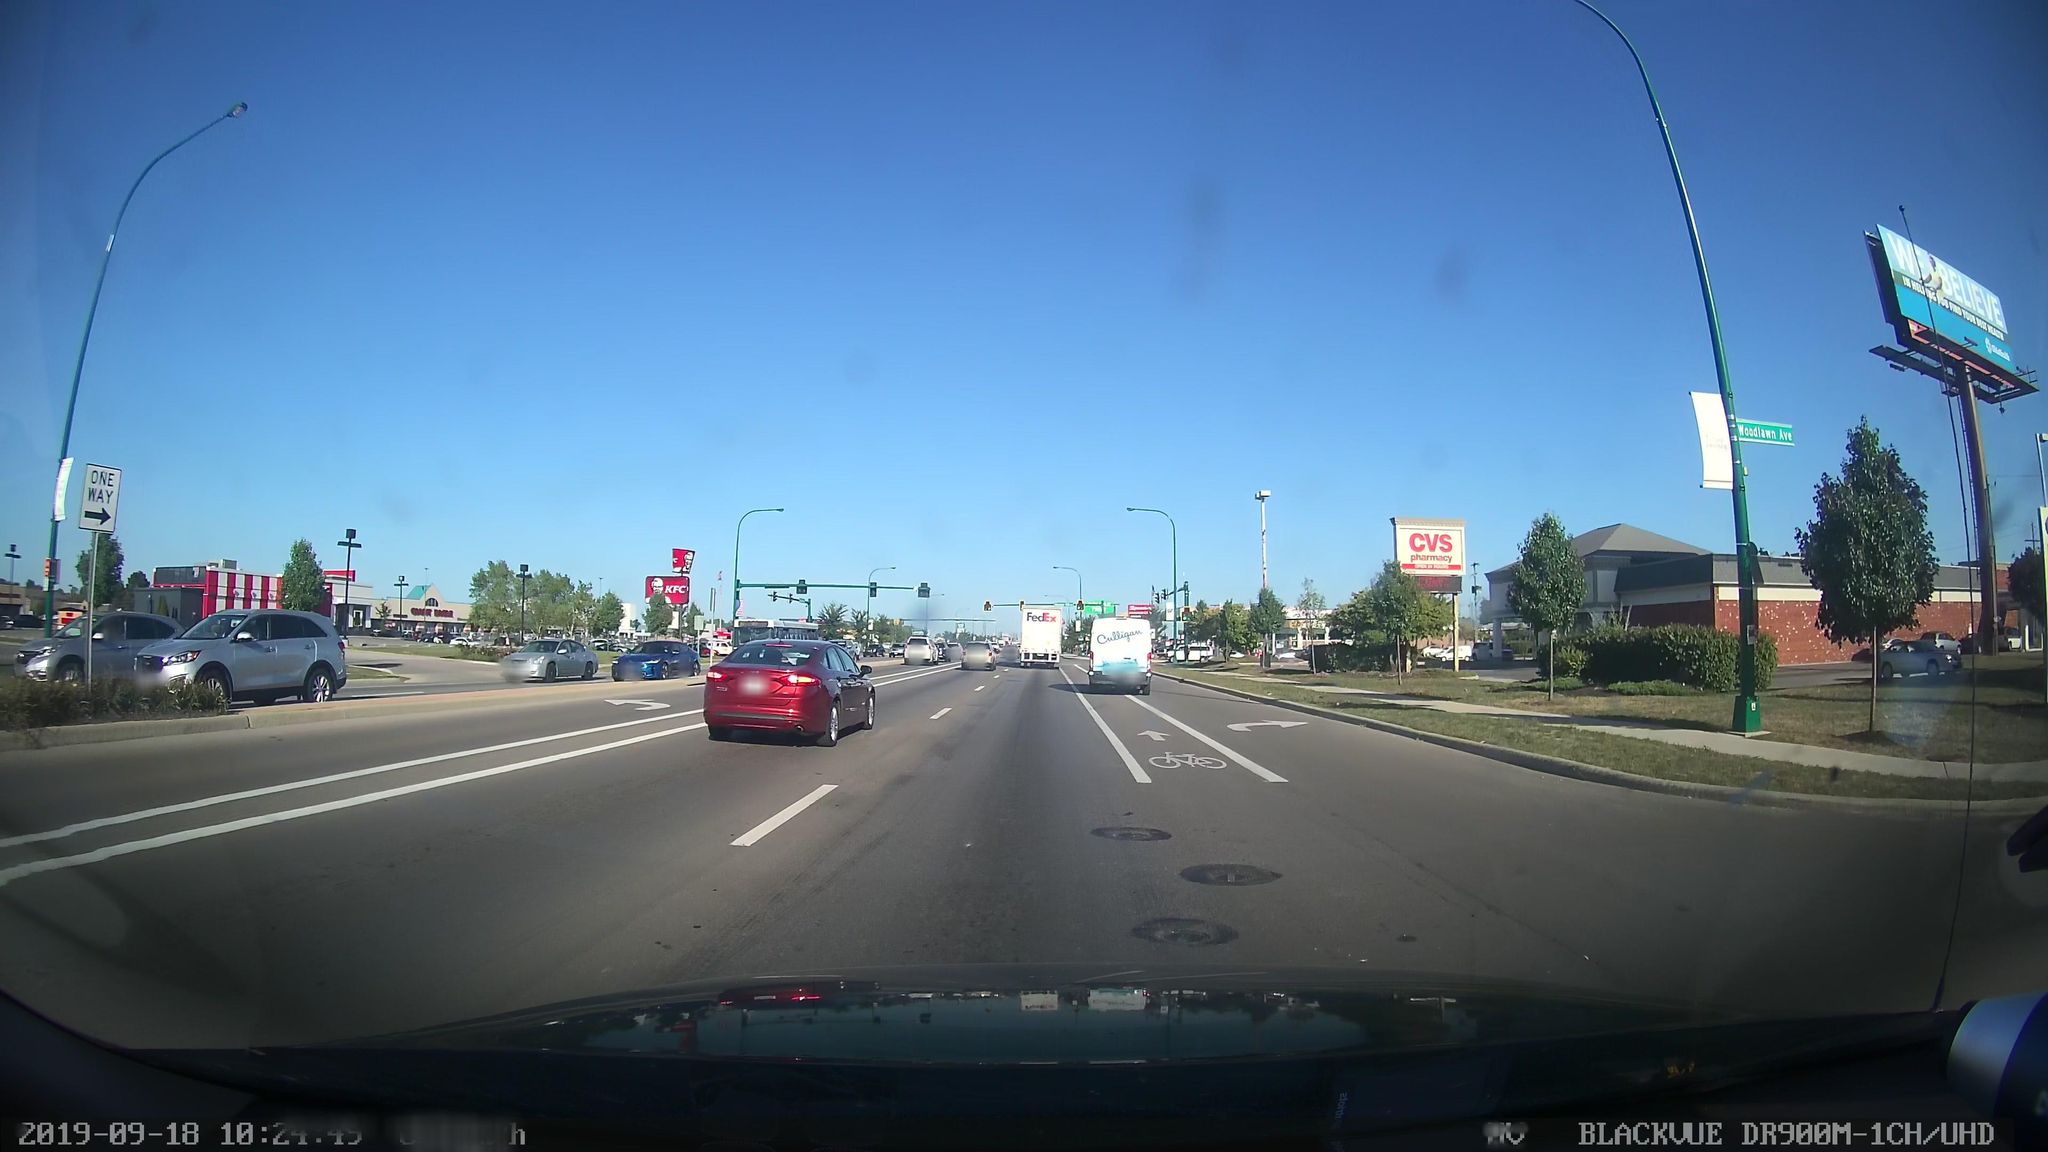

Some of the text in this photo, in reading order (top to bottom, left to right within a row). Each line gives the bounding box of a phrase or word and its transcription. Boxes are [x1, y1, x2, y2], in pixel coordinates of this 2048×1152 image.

[1938, 262, 2004, 329] BELIEVE
[1738, 424, 1792, 441] Woodlawn Ave
[91, 470, 115, 487] ONE
[88, 487, 114, 504] WAY
[1409, 533, 1453, 553] CVS
[1410, 554, 1453, 563] pharmacy
[664, 585, 686, 594] KFC
[1026, 611, 1057, 623] FedEx
[1096, 630, 1143, 645] Culligan
